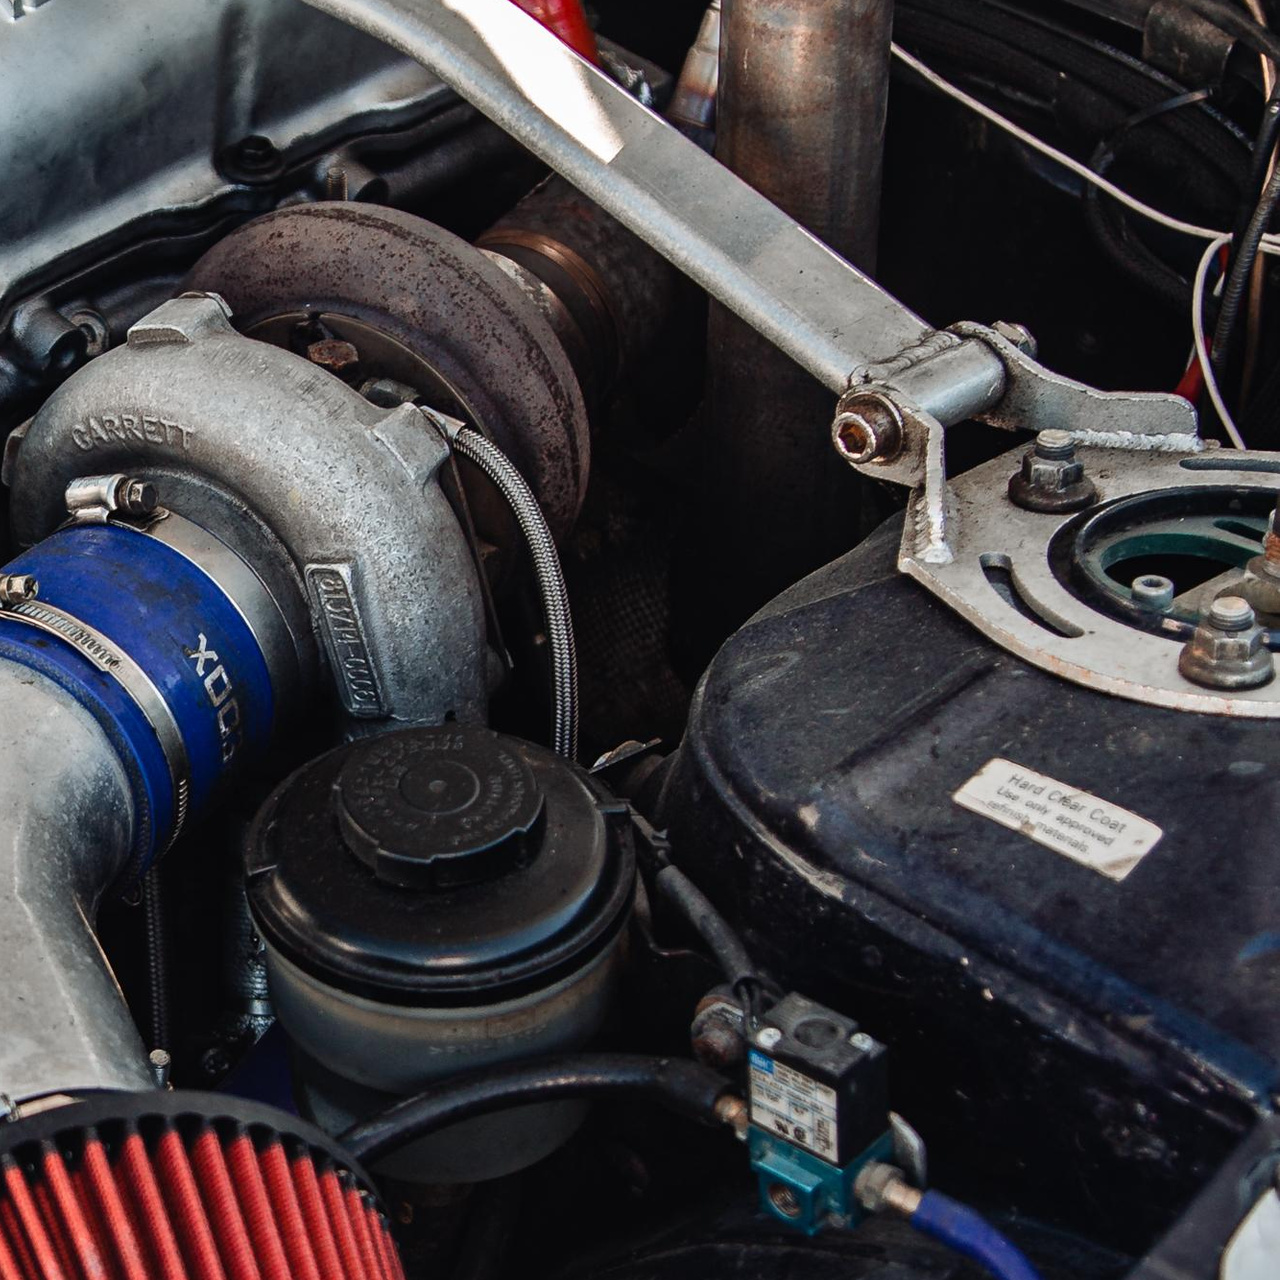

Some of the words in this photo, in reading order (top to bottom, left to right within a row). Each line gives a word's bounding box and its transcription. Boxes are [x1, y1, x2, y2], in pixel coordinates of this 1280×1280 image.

[72, 413, 195, 454] GARRETT
[987, 800, 1030, 825] refinish
[997, 785, 1020, 802] Use
[1025, 799, 1051, 817] only
[1055, 813, 1116, 847] approved
[1008, 773, 1045, 795] Hard
[1047, 789, 1087, 813] Clear
[1089, 808, 1127, 834] Coat
